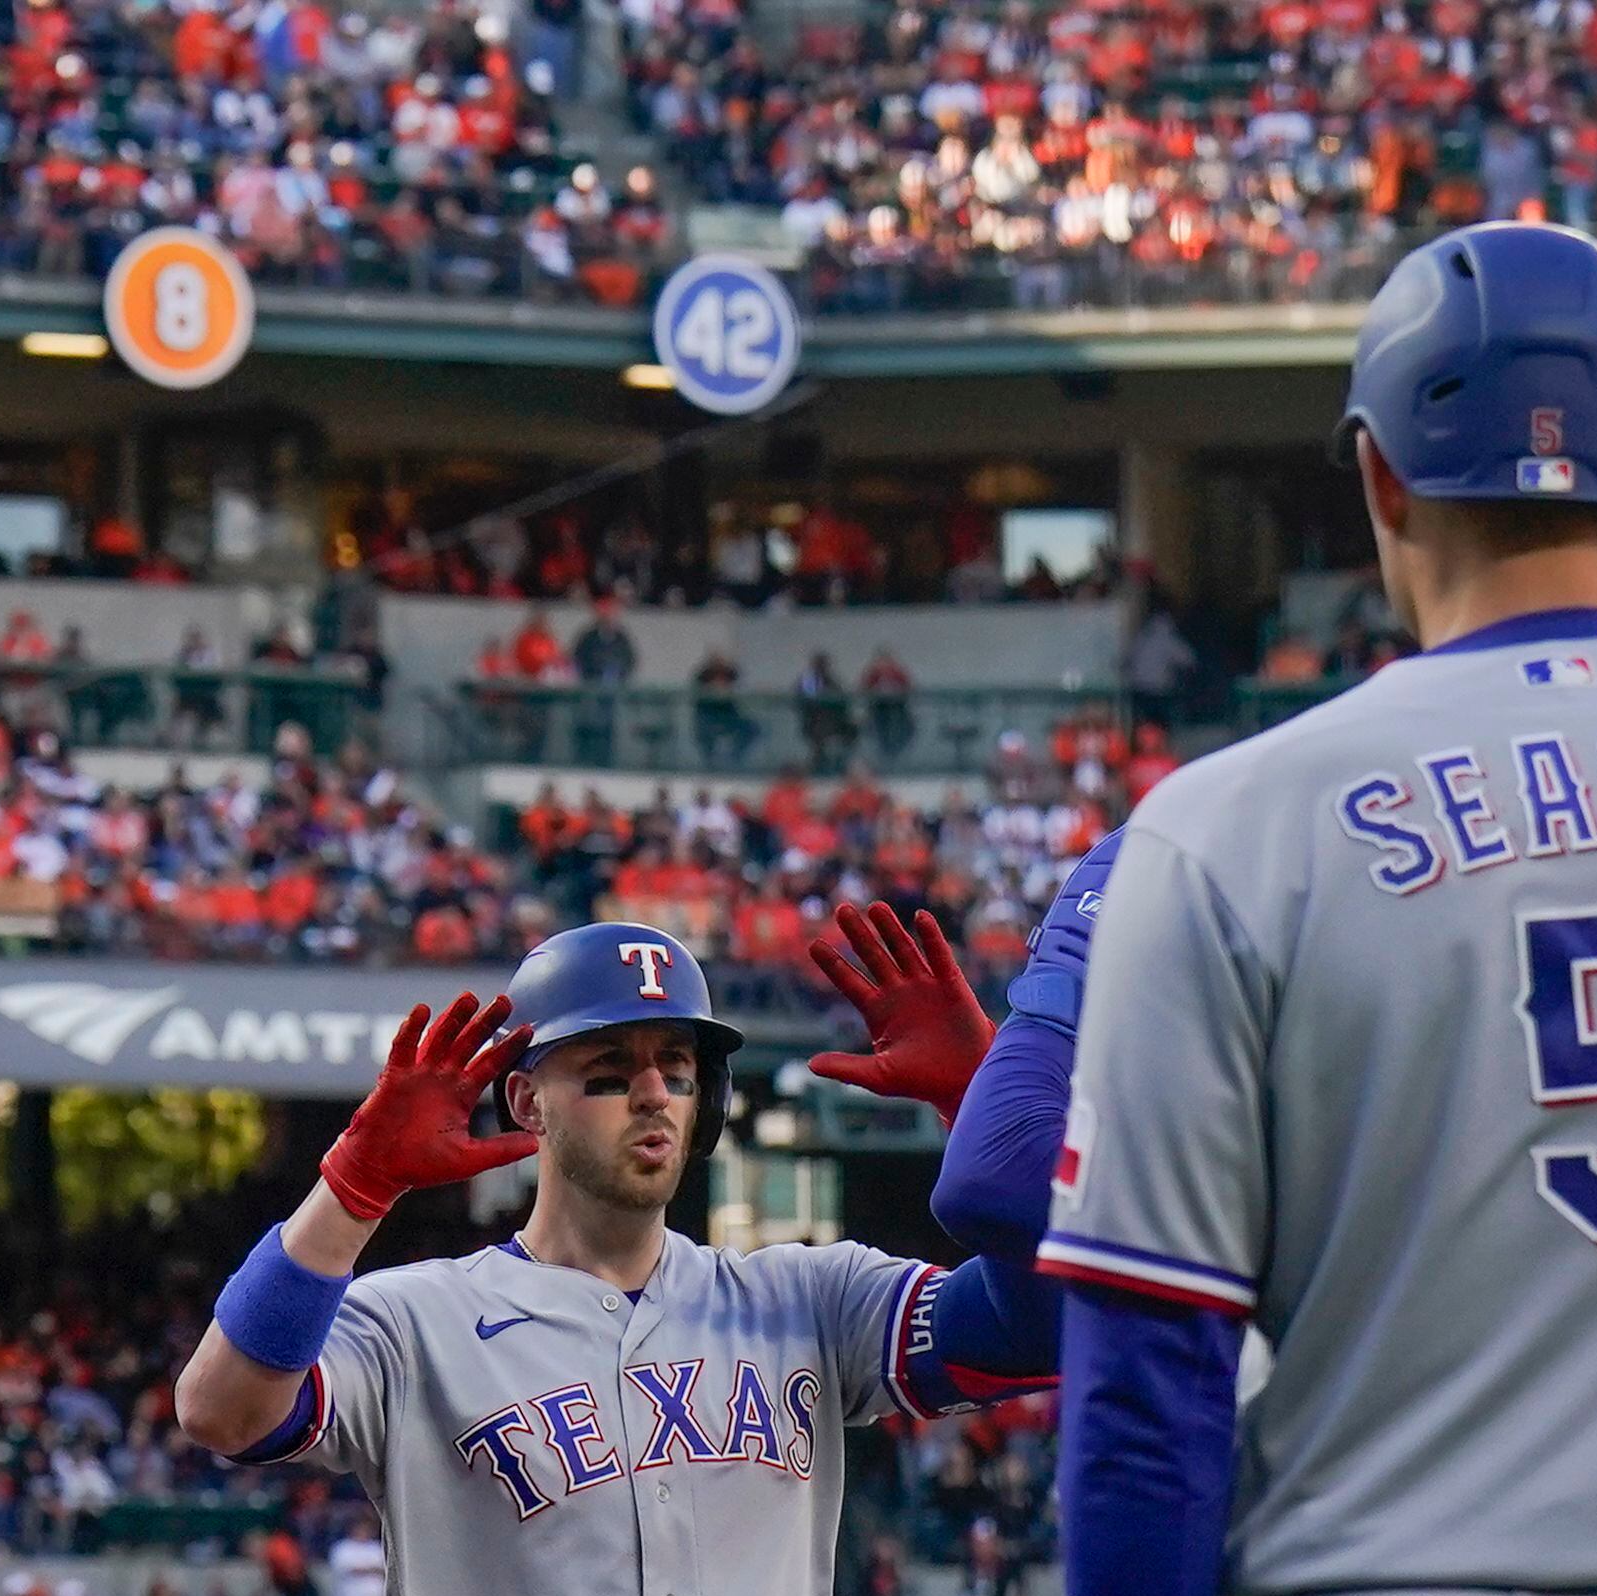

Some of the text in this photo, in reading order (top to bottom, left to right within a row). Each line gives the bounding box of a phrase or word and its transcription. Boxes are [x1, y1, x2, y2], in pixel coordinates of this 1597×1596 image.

[155, 261, 208, 352] 8
[675, 285, 775, 379] 42
[1531, 406, 1564, 456] 5
[618, 942, 673, 1000] T
[454, 1357, 823, 1522] TEXAS
